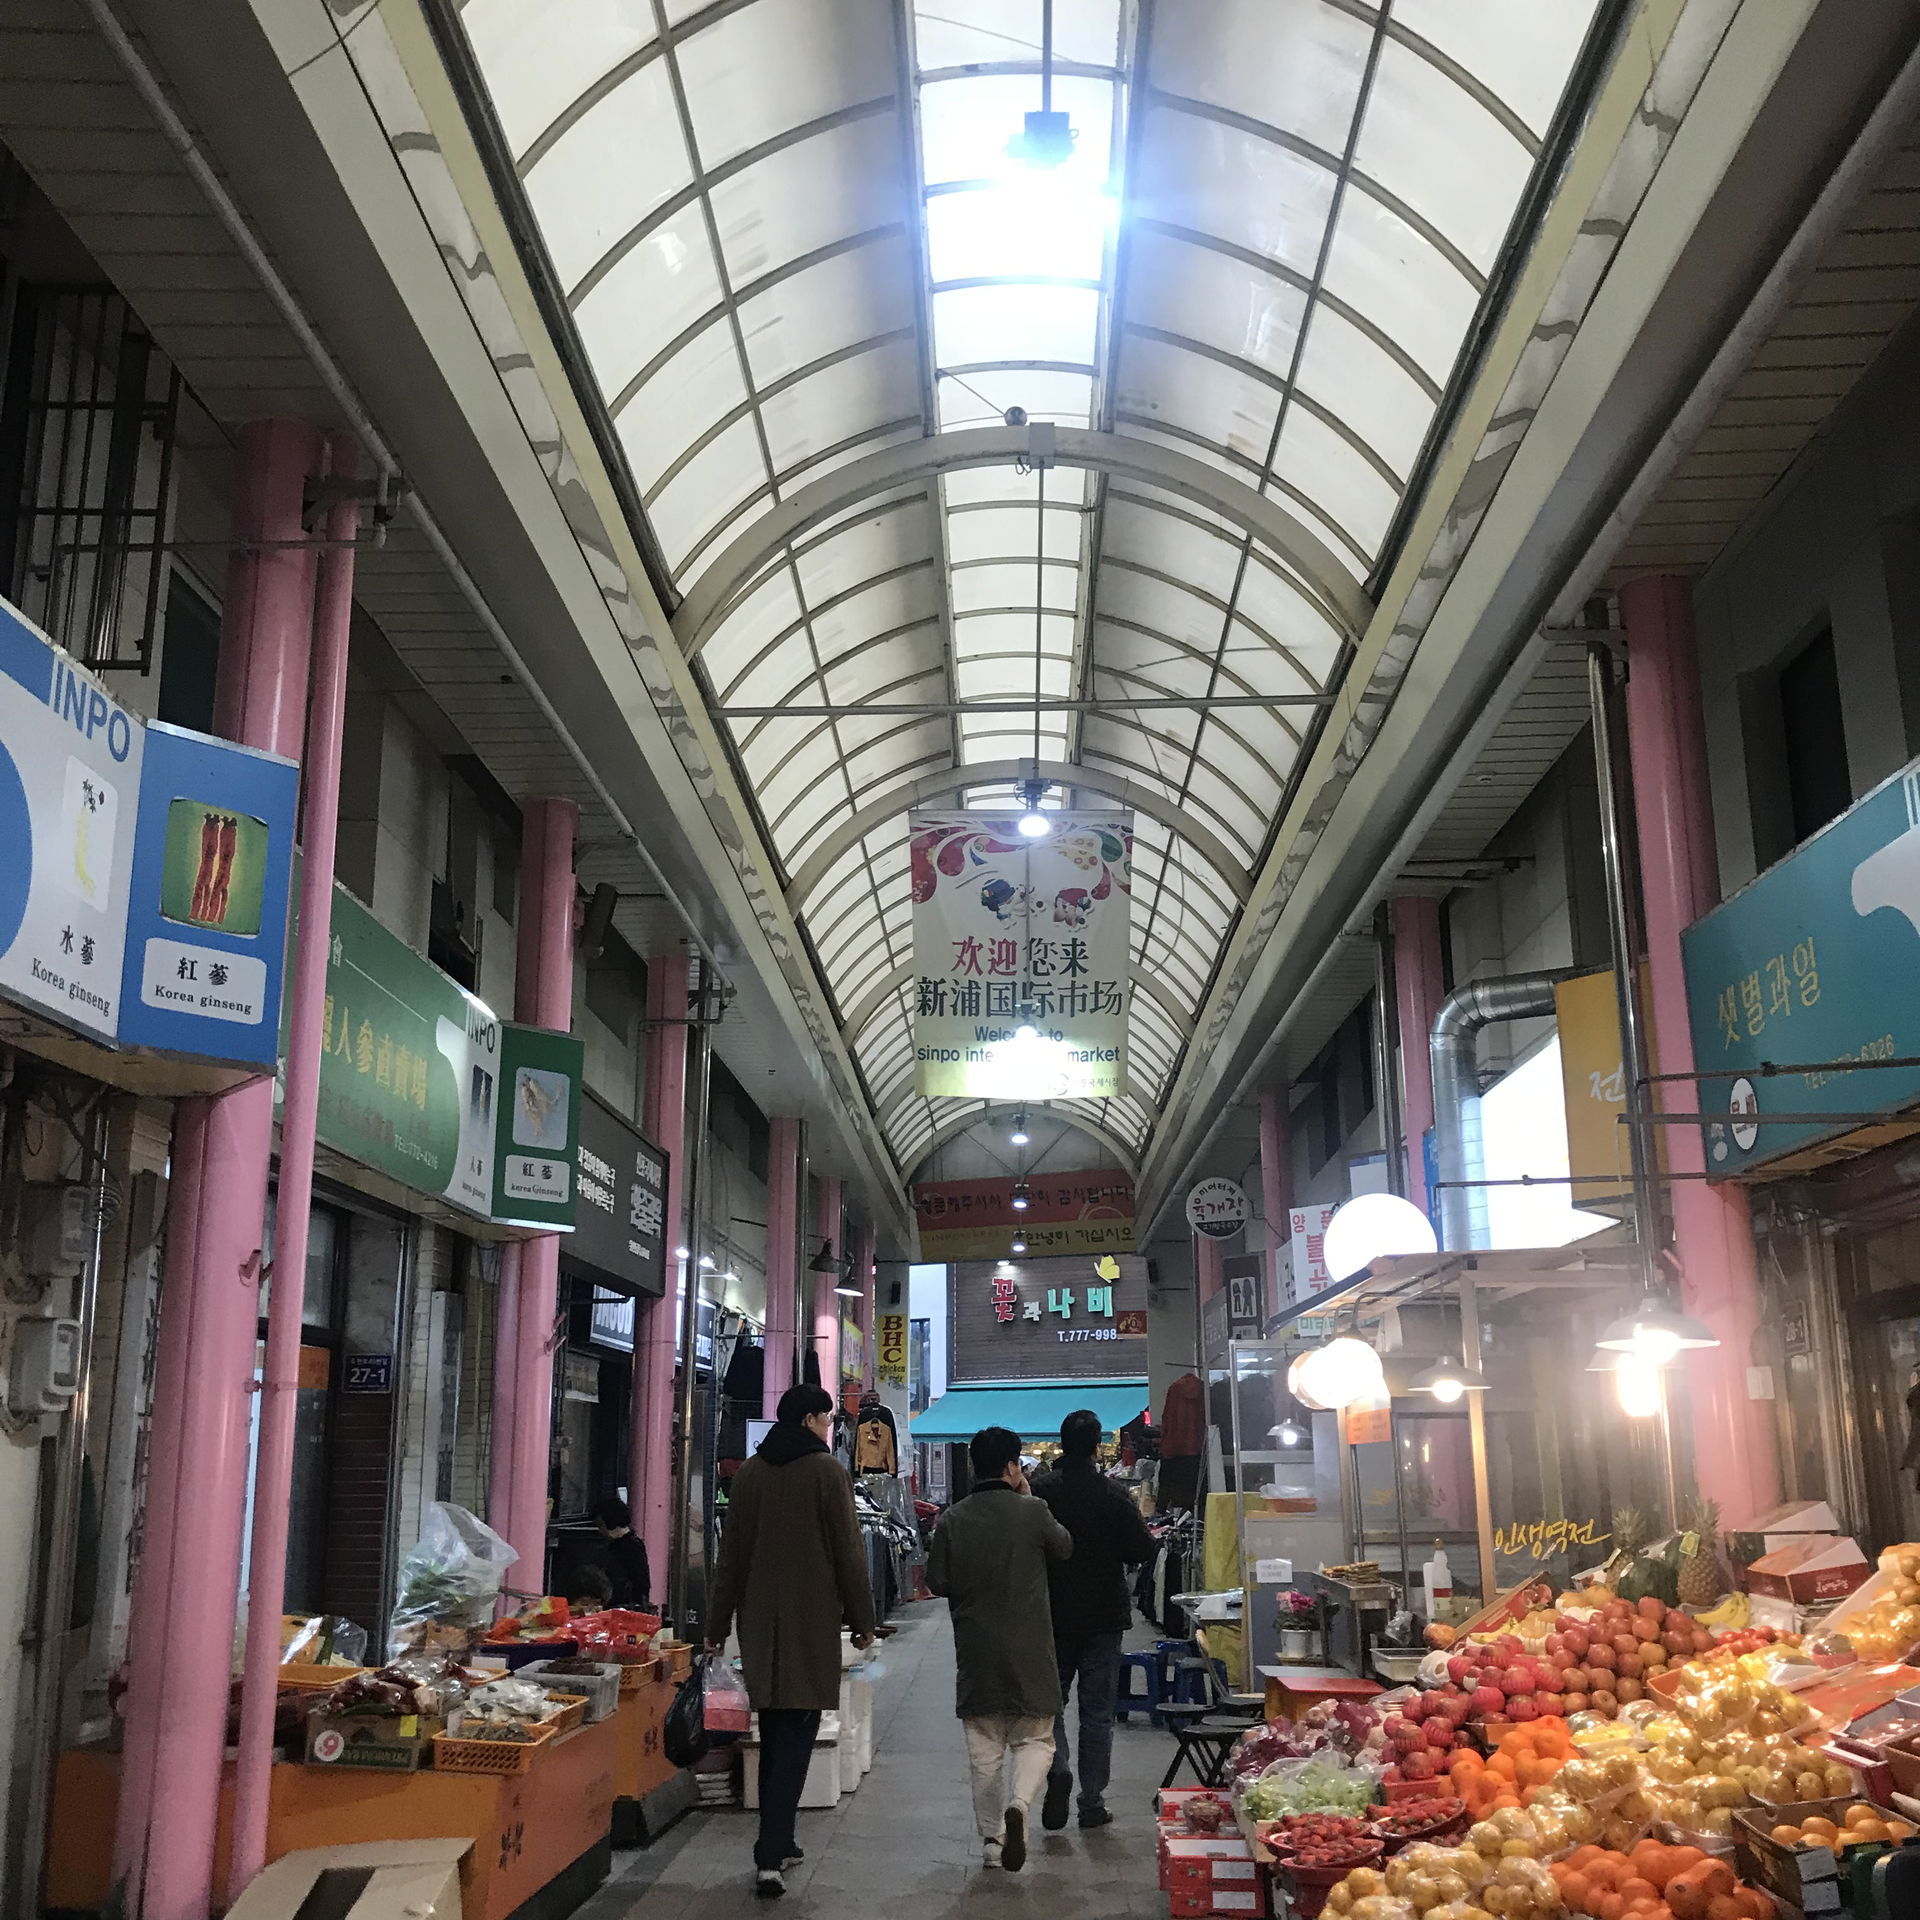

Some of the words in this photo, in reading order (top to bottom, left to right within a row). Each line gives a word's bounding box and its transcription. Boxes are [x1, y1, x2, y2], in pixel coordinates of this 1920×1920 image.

[53, 659, 131, 763] INPO
[951, 936, 1089, 977] 欢迎您来
[31, 957, 67, 995] Korea
[70, 975, 111, 1017] ginseng
[155, 984, 195, 1005] Korea
[200, 991, 253, 1015] ginseng
[916, 976, 1123, 1018] 新浦国际市场
[1719, 936, 1821, 1050] 샛별과일
[975, 1025, 1043, 1042] Welc
[1048, 1027, 1063, 1042] to
[917, 1046, 960, 1064] sinpo
[1068, 1047, 1120, 1062] market
[882, 1316, 902, 1364] BHC
[1057, 1329, 1119, 1342] T.777-998
[349, 1367, 386, 1383] 27-1
